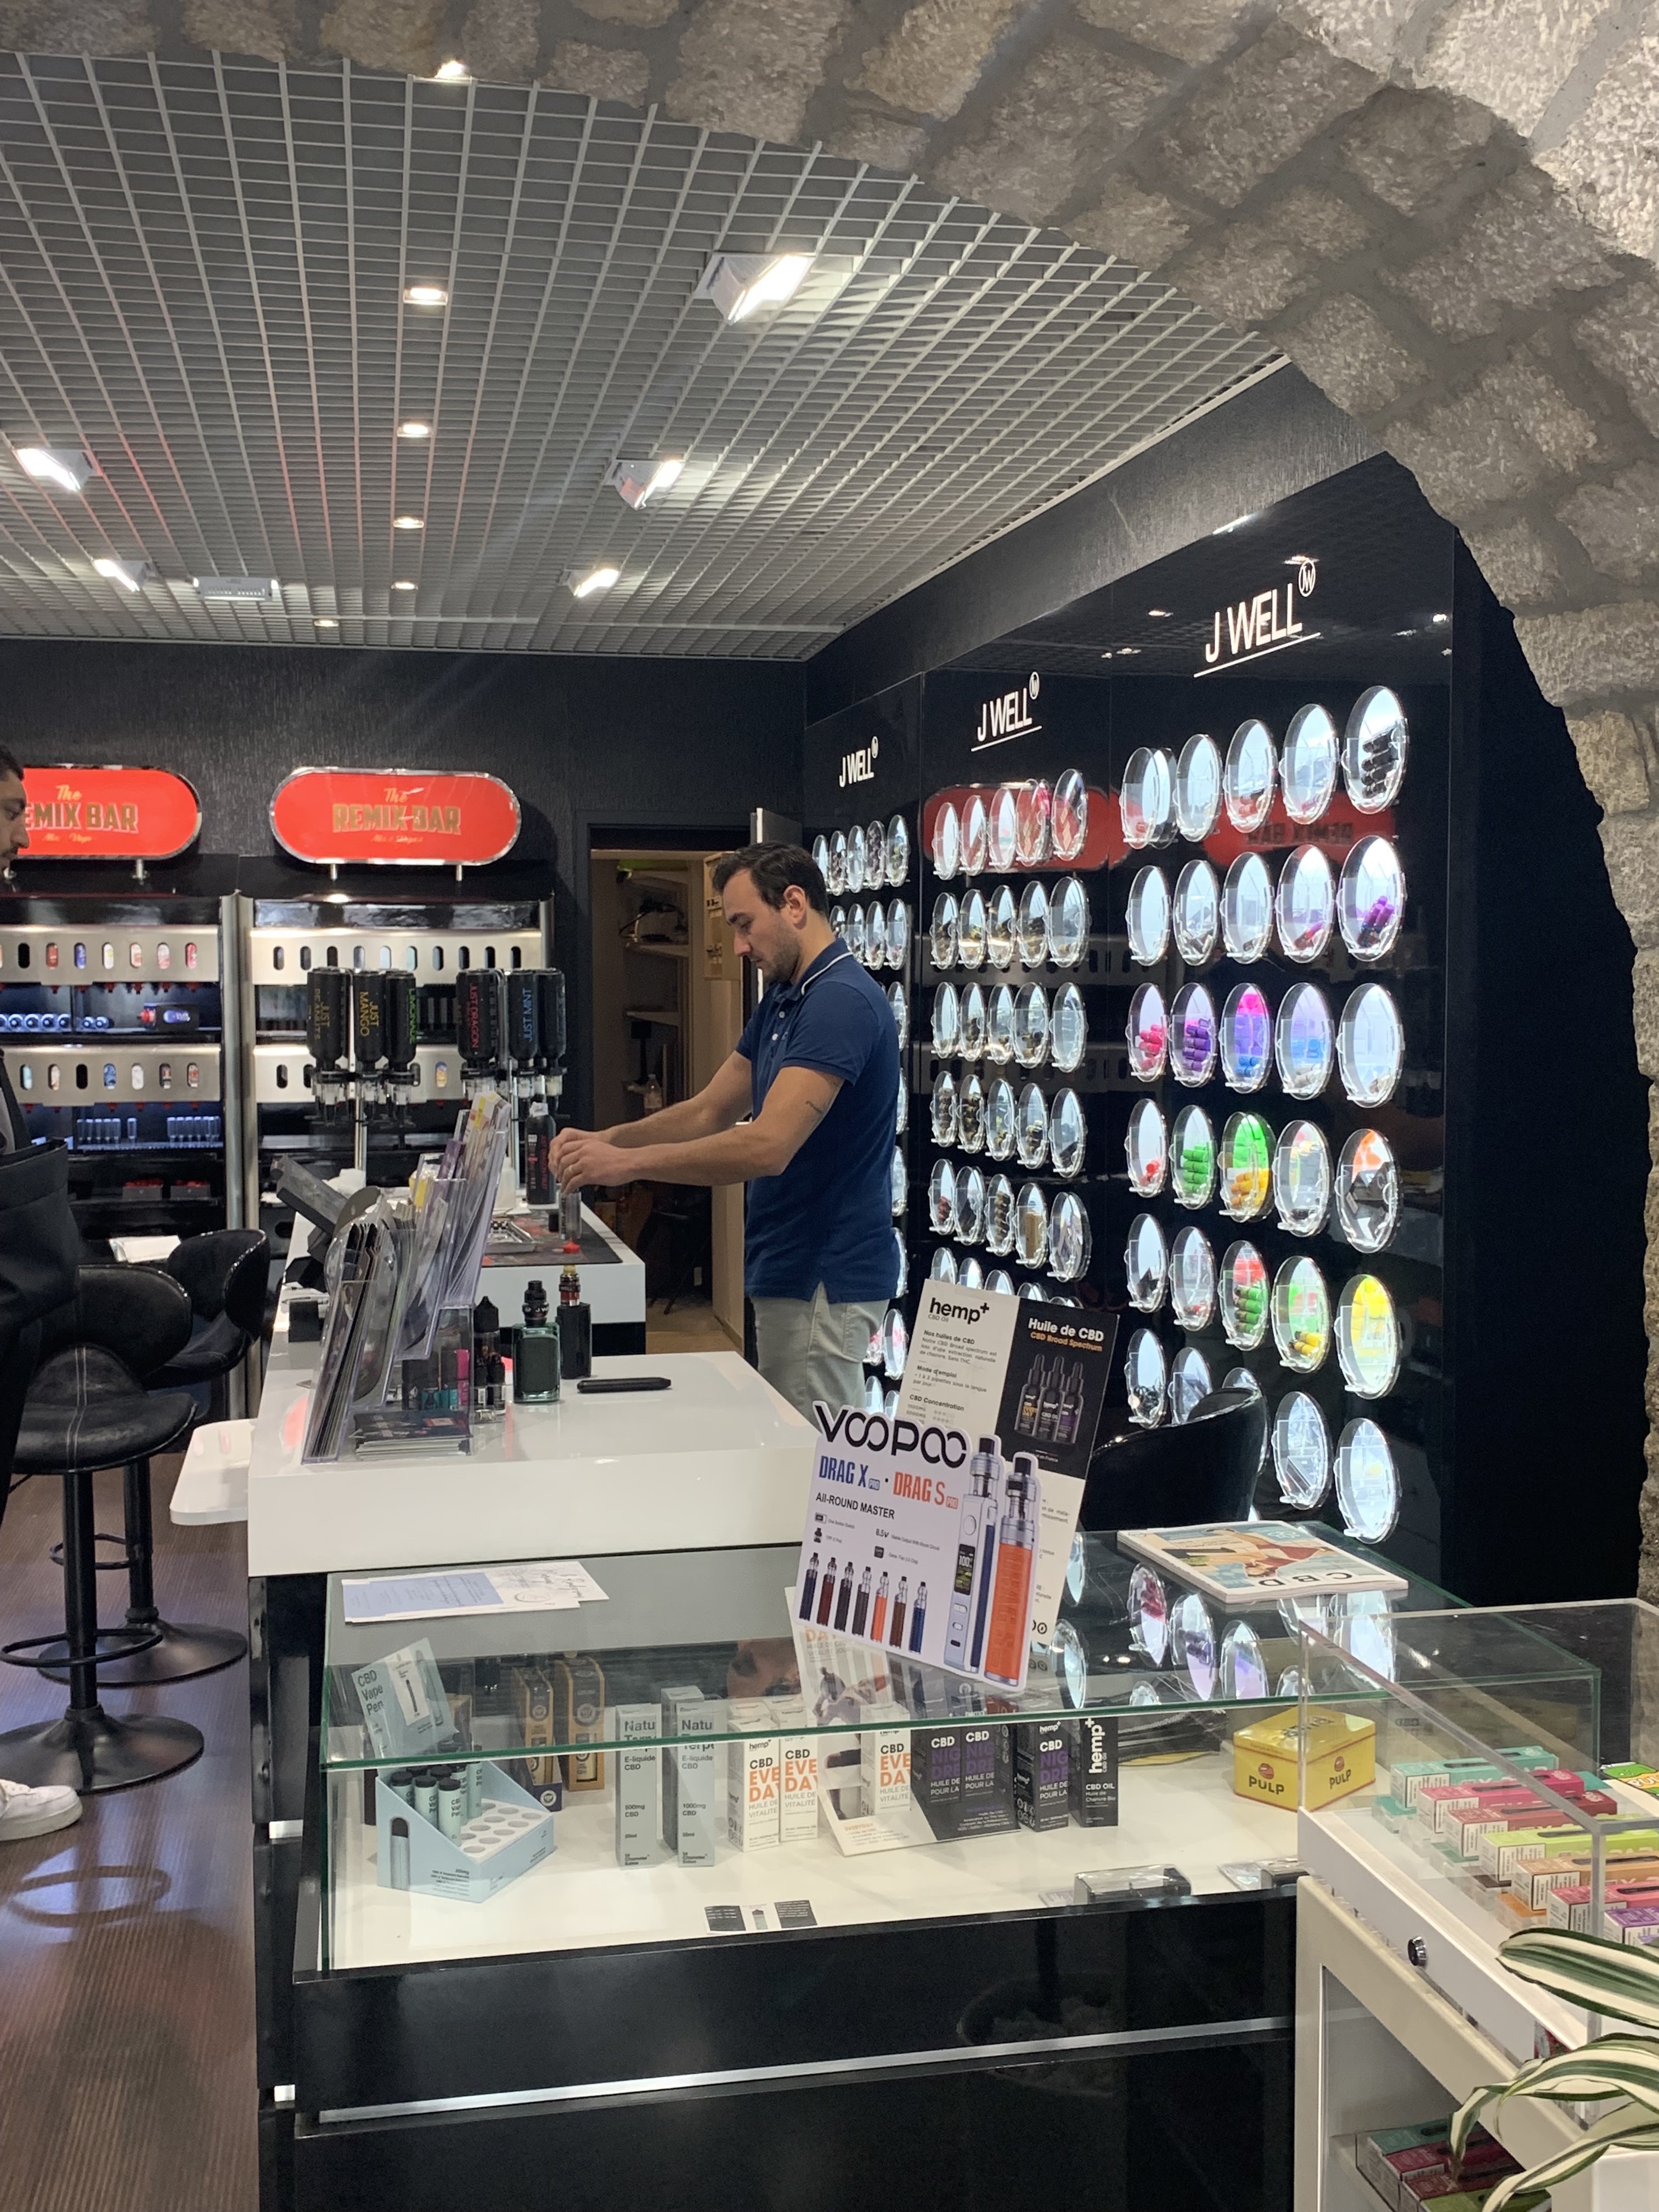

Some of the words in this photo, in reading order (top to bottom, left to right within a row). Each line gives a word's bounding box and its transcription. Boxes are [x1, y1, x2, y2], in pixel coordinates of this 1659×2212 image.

[1206, 612, 1220, 663] J
[1227, 583, 1302, 654] WELL
[978, 704, 986, 741] J
[990, 688, 1032, 737] WELL
[839, 757, 846, 787] J
[847, 748, 874, 784] WELL
[56, 785, 82, 801] The
[384, 788, 409, 803] The
[25, 803, 81, 831] EMIX
[86, 803, 138, 833] BAR
[332, 804, 408, 833] REMIX
[411, 805, 461, 834] BAR
[469, 983, 478, 1005] JUST
[523, 988, 532, 1014] MINT
[320, 1001, 330, 1027] JUST
[360, 991, 370, 1037] MANGO
[370, 1002, 379, 1027] JUST
[471, 1008, 479, 1048] DRAGON
[523, 1017, 533, 1042] JUST
[929, 1297, 990, 1324] hemp+
[1028, 1318, 1058, 1334] Huile
[1060, 1325, 1077, 1337] de
[1078, 1327, 1104, 1342] CBD
[1030, 1331, 1046, 1340] CBD
[1047, 1335, 1068, 1346] Broad
[1069, 1339, 1103, 1352] Spectrum
[933, 1369, 957, 1378] d'emploi
[923, 1397, 964, 1411] Concentration
[814, 1404, 968, 1469] VOOPOO
[819, 1455, 855, 1485] DRAG
[857, 1464, 869, 1488] X
[893, 1471, 932, 1503] DRAG
[934, 1481, 945, 1505] S
[946, 1497, 957, 1509] PRO
[860, 1503, 895, 1520] MASTER
[358, 1669, 377, 1687] CBD
[361, 1684, 383, 1701] Vape
[366, 1700, 384, 1716] Pen
[624, 1720, 656, 1731] Natu
[682, 1720, 712, 1730] Natu
[931, 1736, 955, 1748] CBD
[966, 1730, 989, 1742] CBD
[785, 1749, 810, 1759] CBD
[880, 1743, 904, 1754] CBD
[1040, 1740, 1063, 1752] CBD
[1085, 1718, 1105, 1774] hemp+
[625, 1755, 656, 1763] E-liquide
[750, 1757, 773, 1769] CBD
[785, 1759, 817, 1776] EVE
[880, 1753, 911, 1770] EVE
[749, 1767, 780, 1786] EVE
[1249, 1775, 1284, 1795] PULP
[1329, 1769, 1351, 1790] PULP
[1040, 1782, 1058, 1791] HUILE
[1040, 1791, 1058, 1799] POUR
[749, 1802, 768, 1810] HUILE
